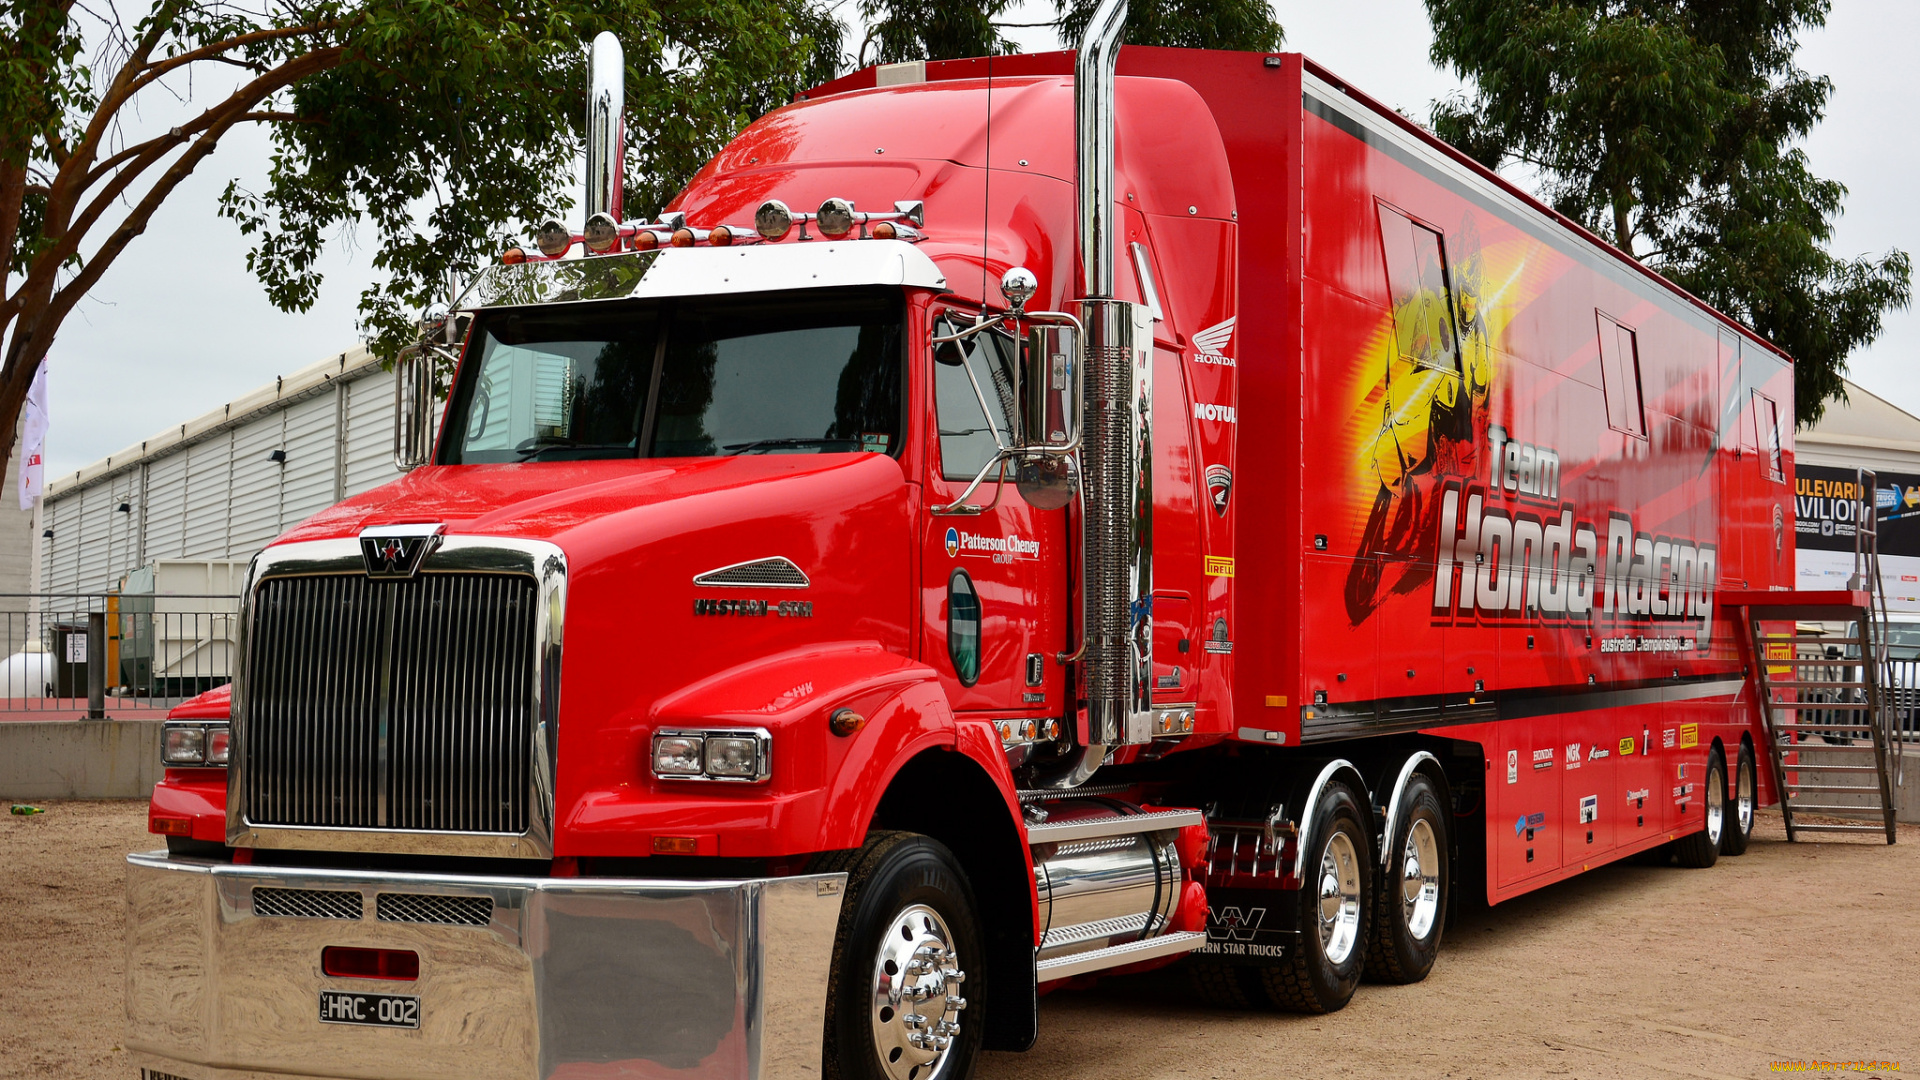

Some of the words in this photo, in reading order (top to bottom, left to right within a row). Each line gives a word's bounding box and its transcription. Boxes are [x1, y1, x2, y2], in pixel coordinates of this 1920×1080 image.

[1194, 354, 1236, 367] HONDA
[1194, 403, 1236, 423] MOTUL
[1488, 425, 1559, 499] Team
[960, 531, 1006, 551] Patterson
[1007, 535, 1040, 558] Cheney
[992, 553, 1013, 564] GROUP
[1434, 488, 1598, 614] Honda
[1603, 517, 1716, 650] Racing
[695, 599, 768, 616] WESTERN
[778, 601, 813, 617] STAR
[1601, 634, 1637, 653] australian
[1637, 634, 1678, 655] hampionship
[1533, 748, 1554, 761] HONDA
[1566, 743, 1581, 763] NGK
[1223, 942, 1245, 955] STAR
[1248, 944, 1283, 957] TRUCKS
